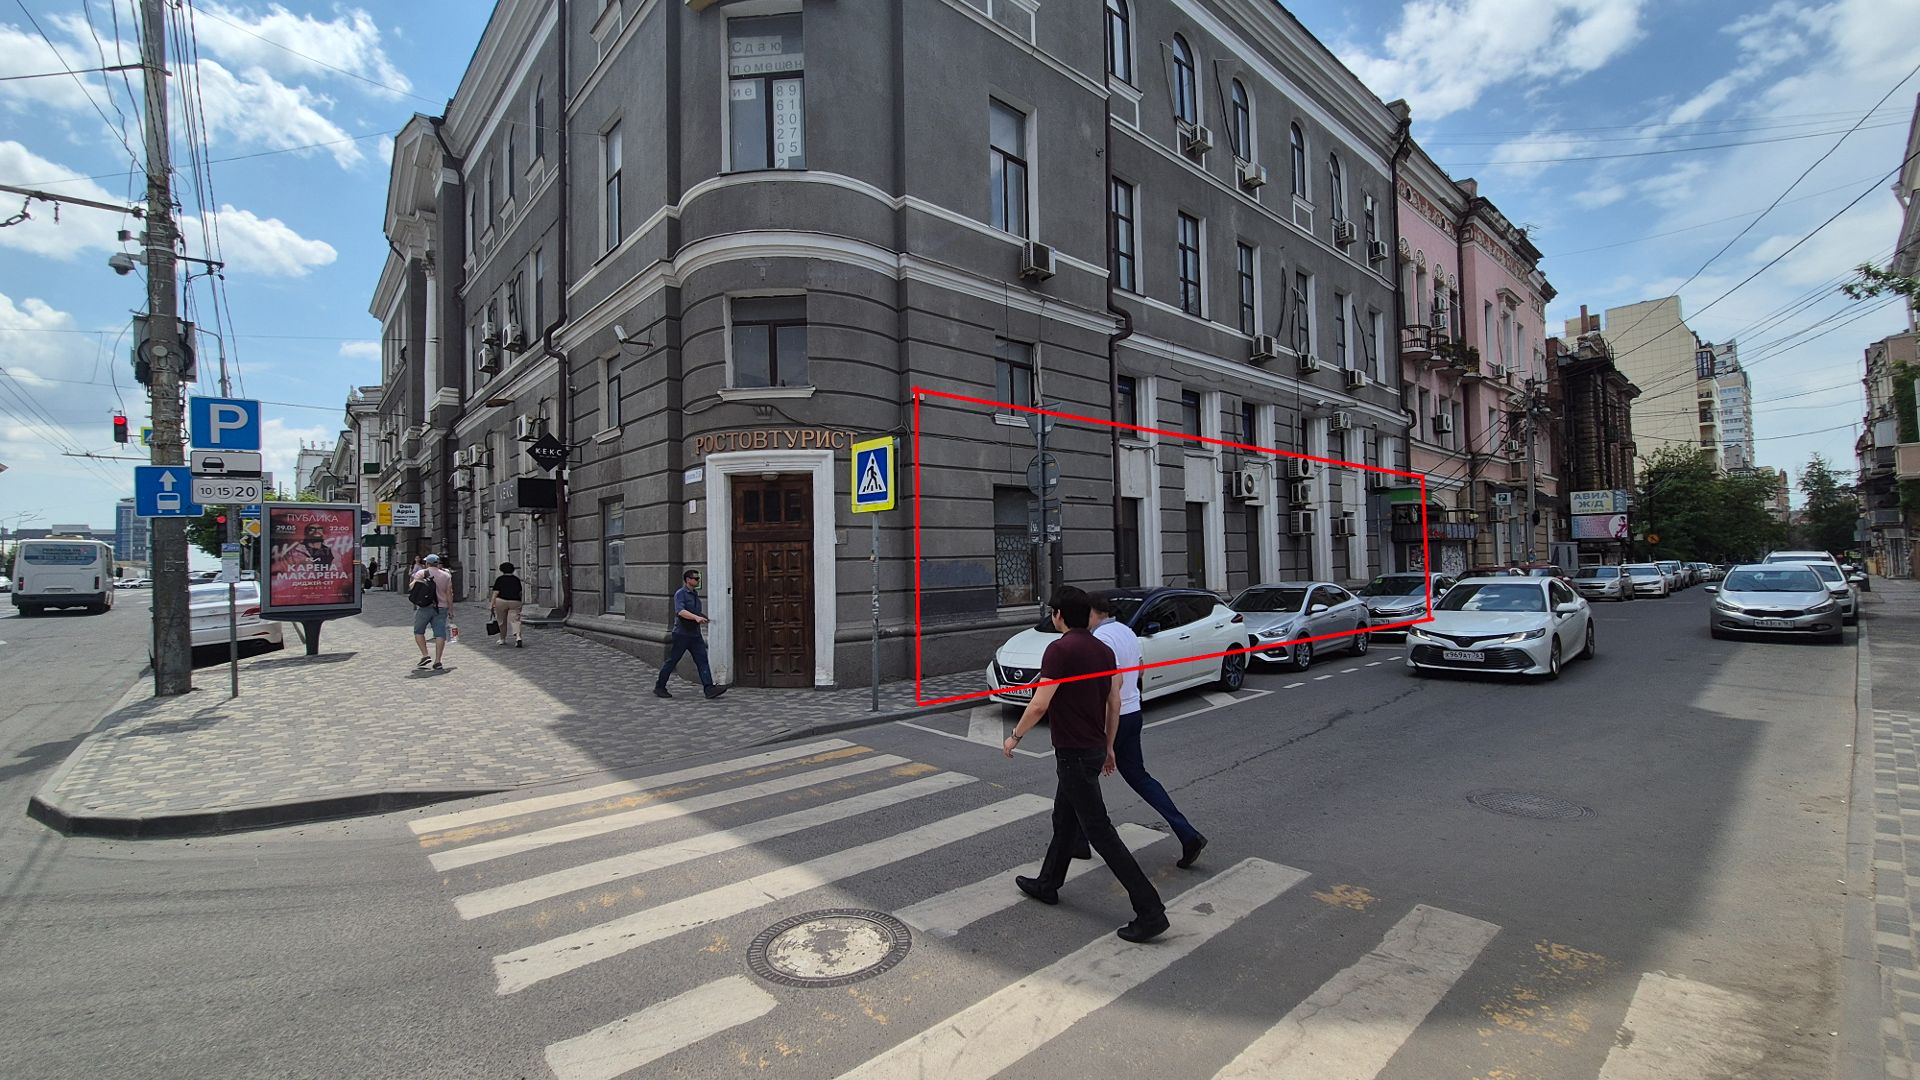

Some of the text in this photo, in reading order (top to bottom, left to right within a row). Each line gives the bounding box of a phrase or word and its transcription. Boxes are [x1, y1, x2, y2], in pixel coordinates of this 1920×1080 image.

[731, 41, 781, 54] Сдаю
[732, 60, 802, 74] помещен
[732, 87, 753, 97] ие
[210, 403, 249, 444] P
[695, 429, 858, 456] РОСТОВТУРИСТ
[200, 486, 256, 497] 10 15 20
[1574, 491, 1609, 500] АВИА
[1579, 500, 1604, 508] Ж/Д
[287, 513, 339, 522] ПУБЛИКА
[287, 563, 339, 572] КАРЕНА
[276, 571, 349, 580] МАКАРЕНА
